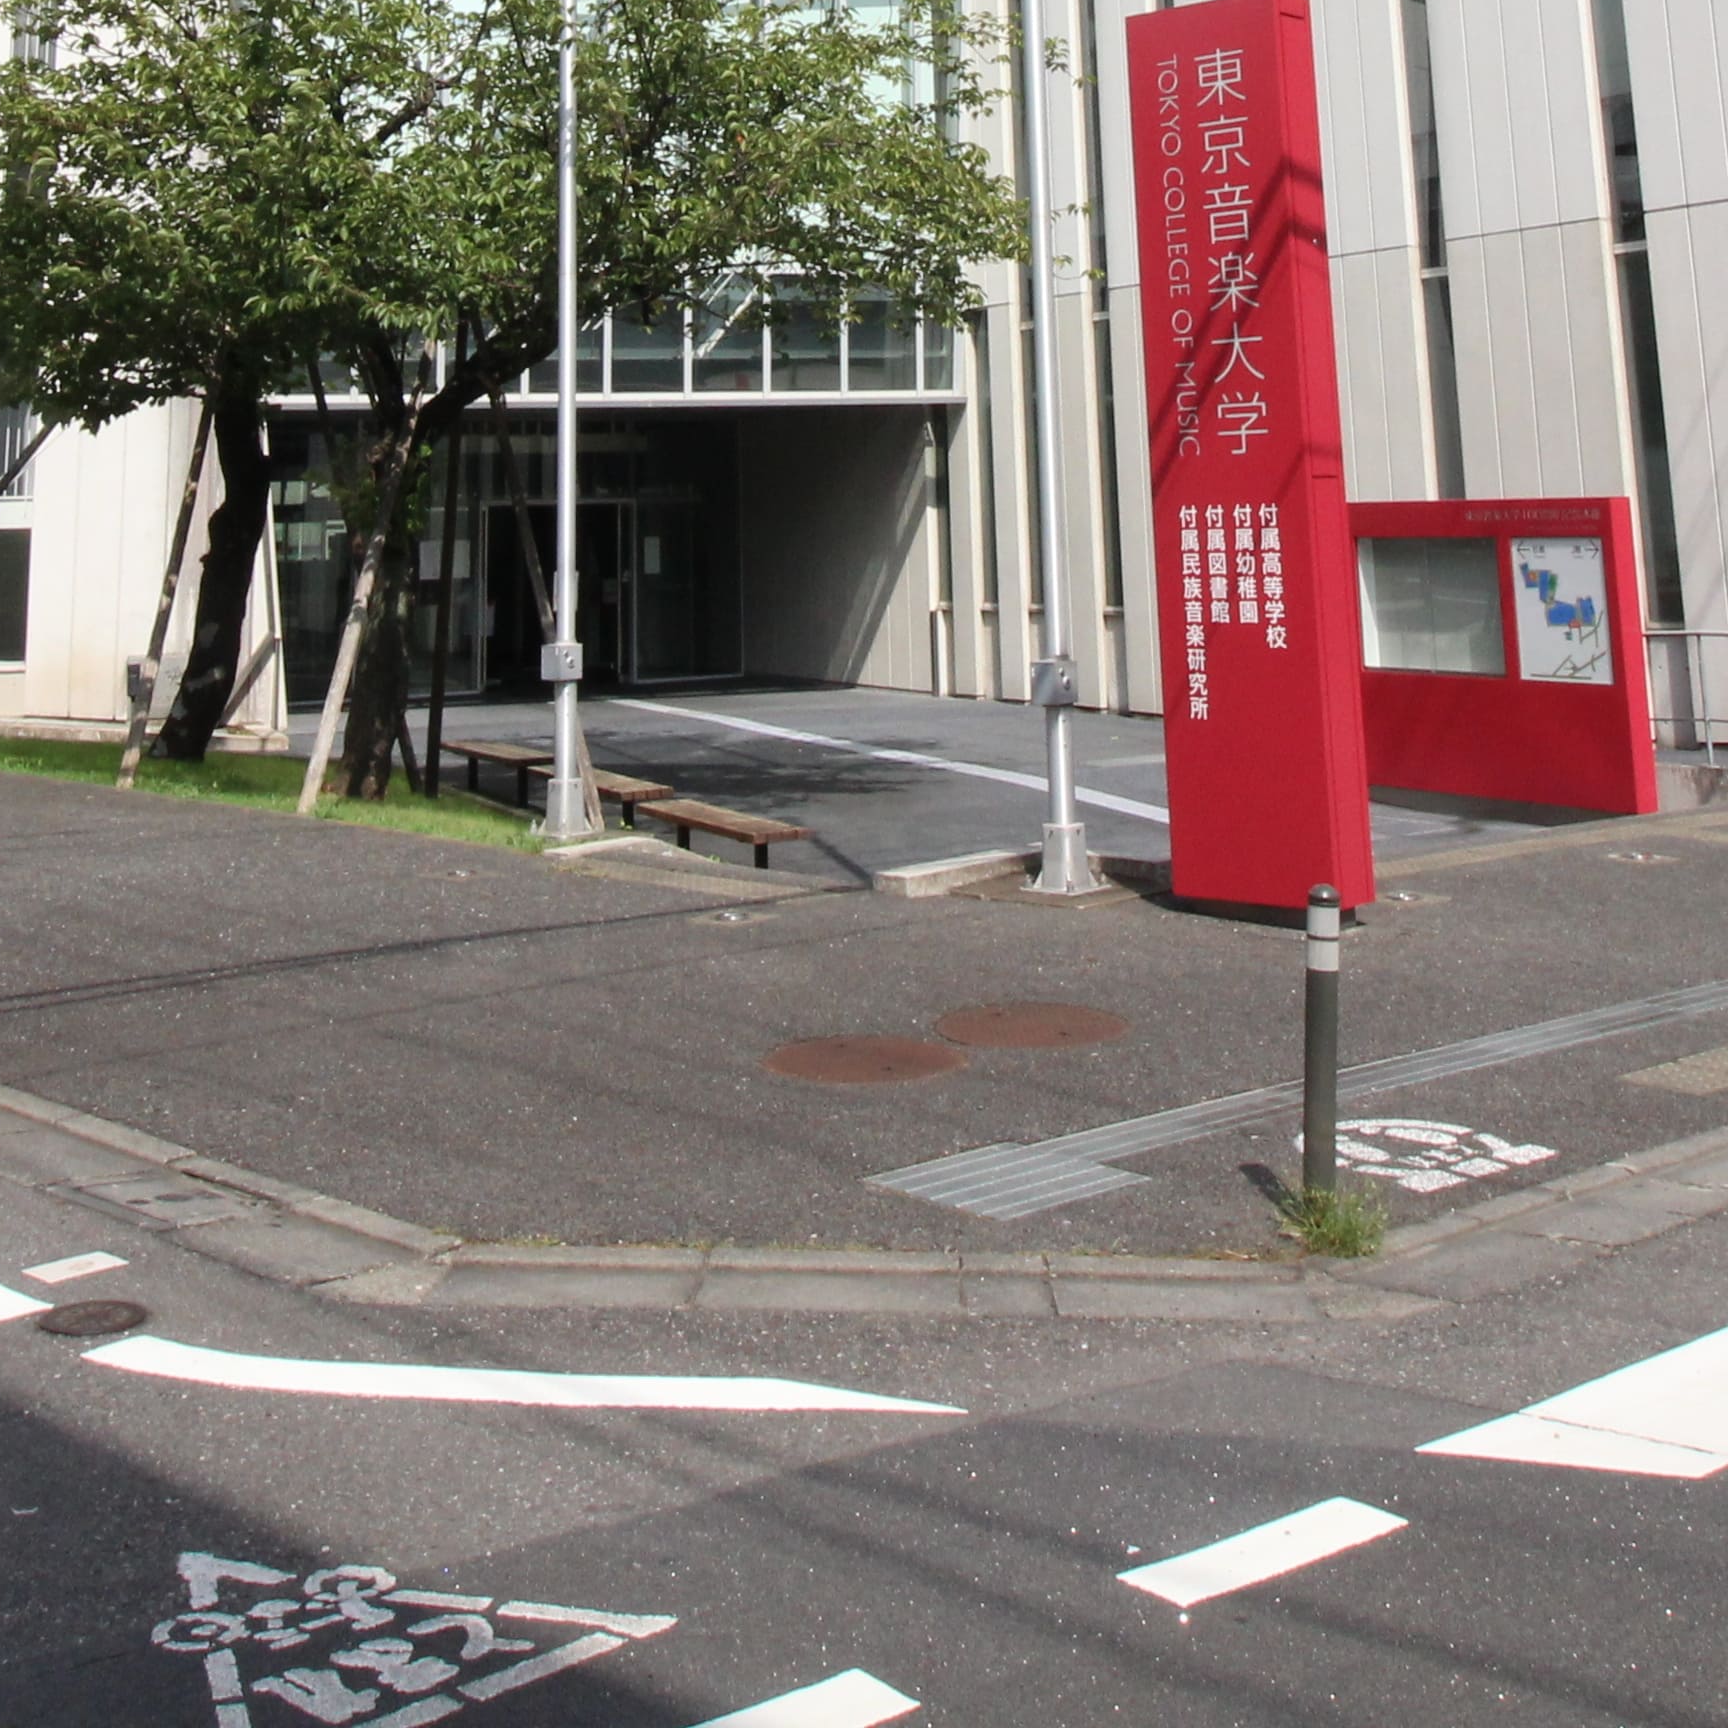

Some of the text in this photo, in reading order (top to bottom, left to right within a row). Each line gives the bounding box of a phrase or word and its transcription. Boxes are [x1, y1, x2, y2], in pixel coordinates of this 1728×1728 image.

[1156, 53, 1201, 458] TOKYO COLLEGE OF MUSIC
[1193, 47, 1270, 456] 東京音楽大学
[1179, 505, 1208, 720] 付属民族音楽研究所
[1205, 504, 1230, 624] 付属図書館
[1233, 503, 1259, 624] 付属幼稚園
[1258, 503, 1288, 649] 付属高等学校
